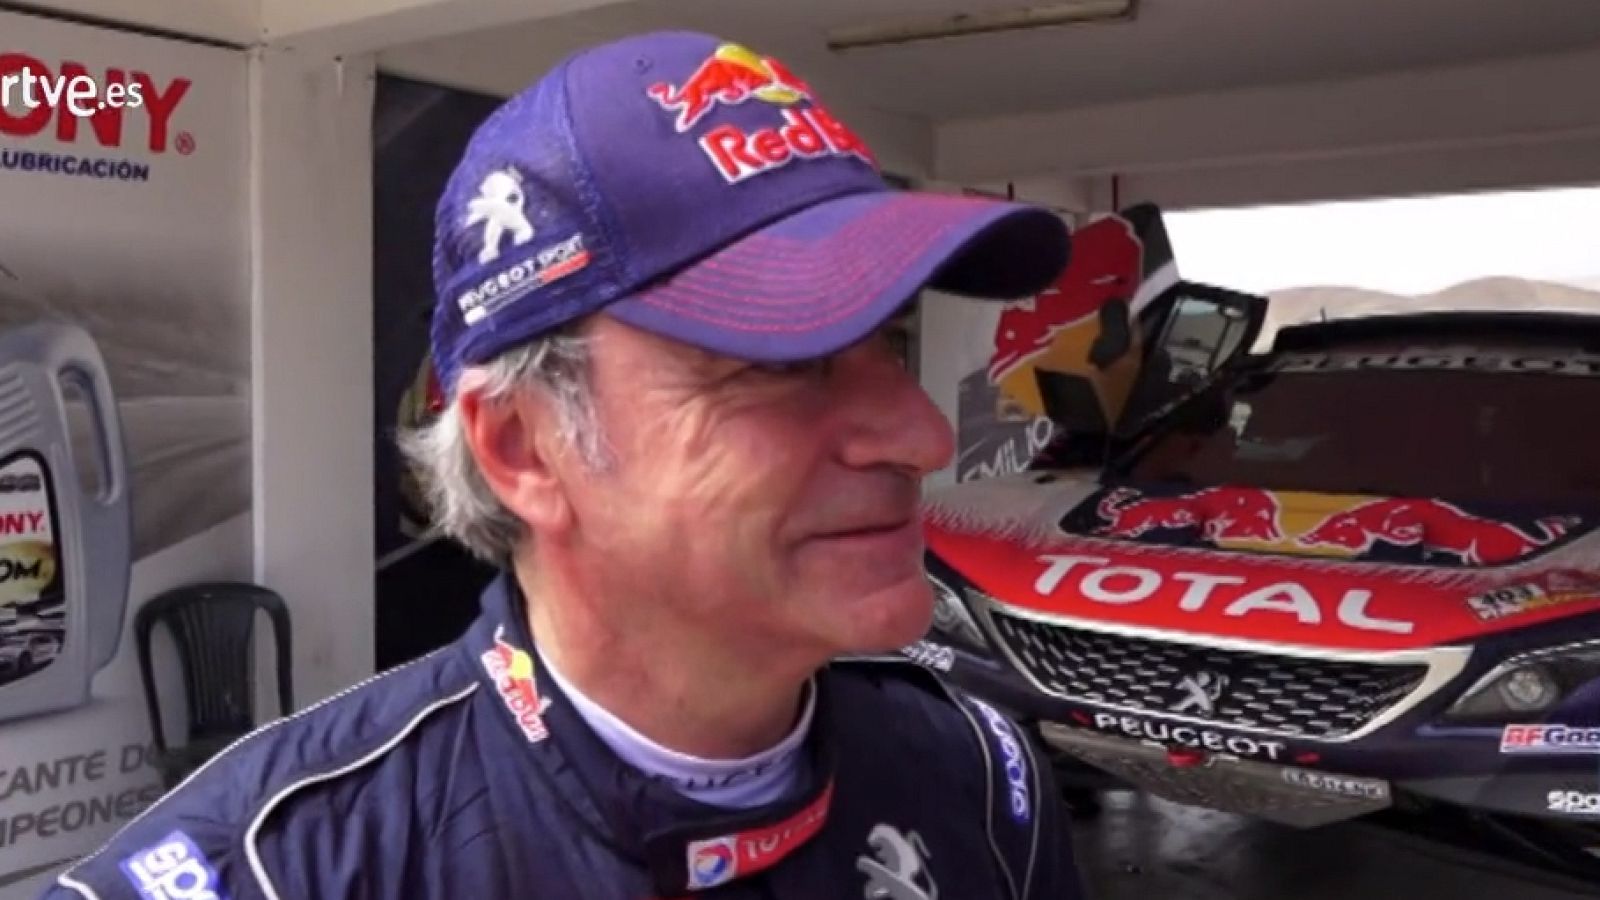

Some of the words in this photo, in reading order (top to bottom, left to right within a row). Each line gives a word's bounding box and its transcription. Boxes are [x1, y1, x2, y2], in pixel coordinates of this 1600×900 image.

[0, 151, 149, 181] UBRICACIÓN
[699, 109, 829, 184] Red
[1034, 554, 1414, 634] TOTAL
[119, 744, 152, 773] D
[1095, 713, 1284, 760] PEUGEOT
